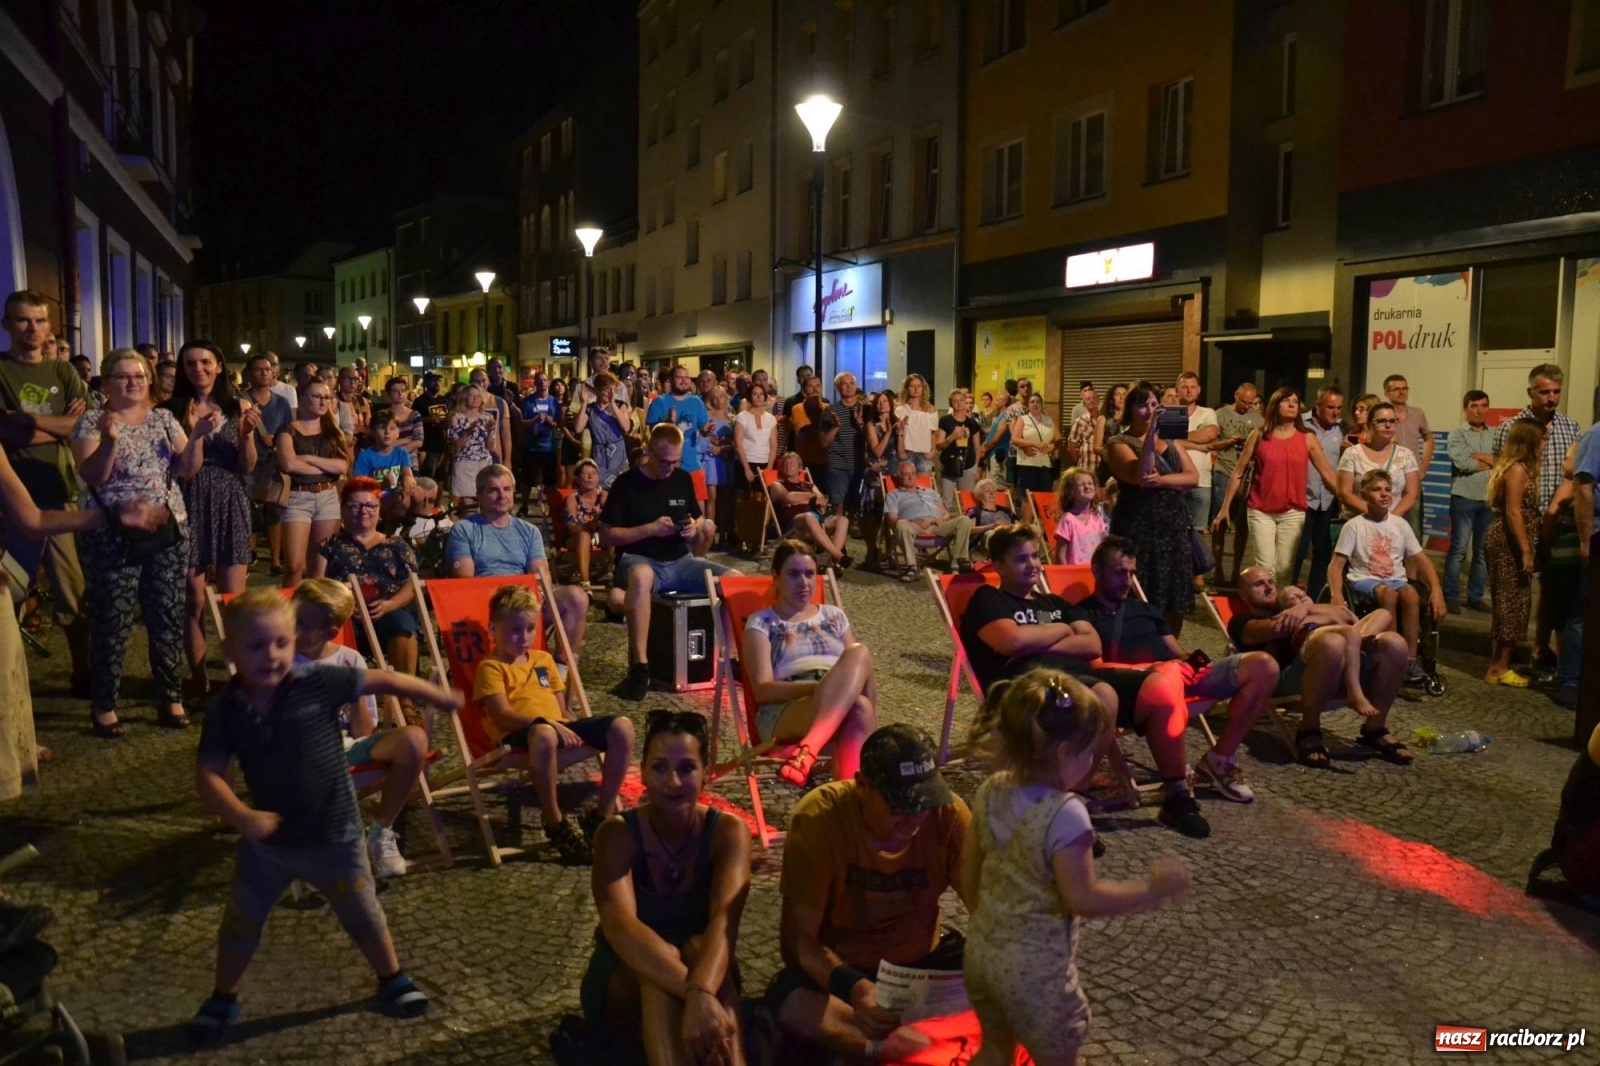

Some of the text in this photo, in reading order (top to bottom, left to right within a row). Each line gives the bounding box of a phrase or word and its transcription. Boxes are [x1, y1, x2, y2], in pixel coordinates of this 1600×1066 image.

[1374, 307, 1422, 320] drukarnia
[1018, 358, 1045, 369] KREDYTY
[881, 967, 925, 980] PROGRAM
